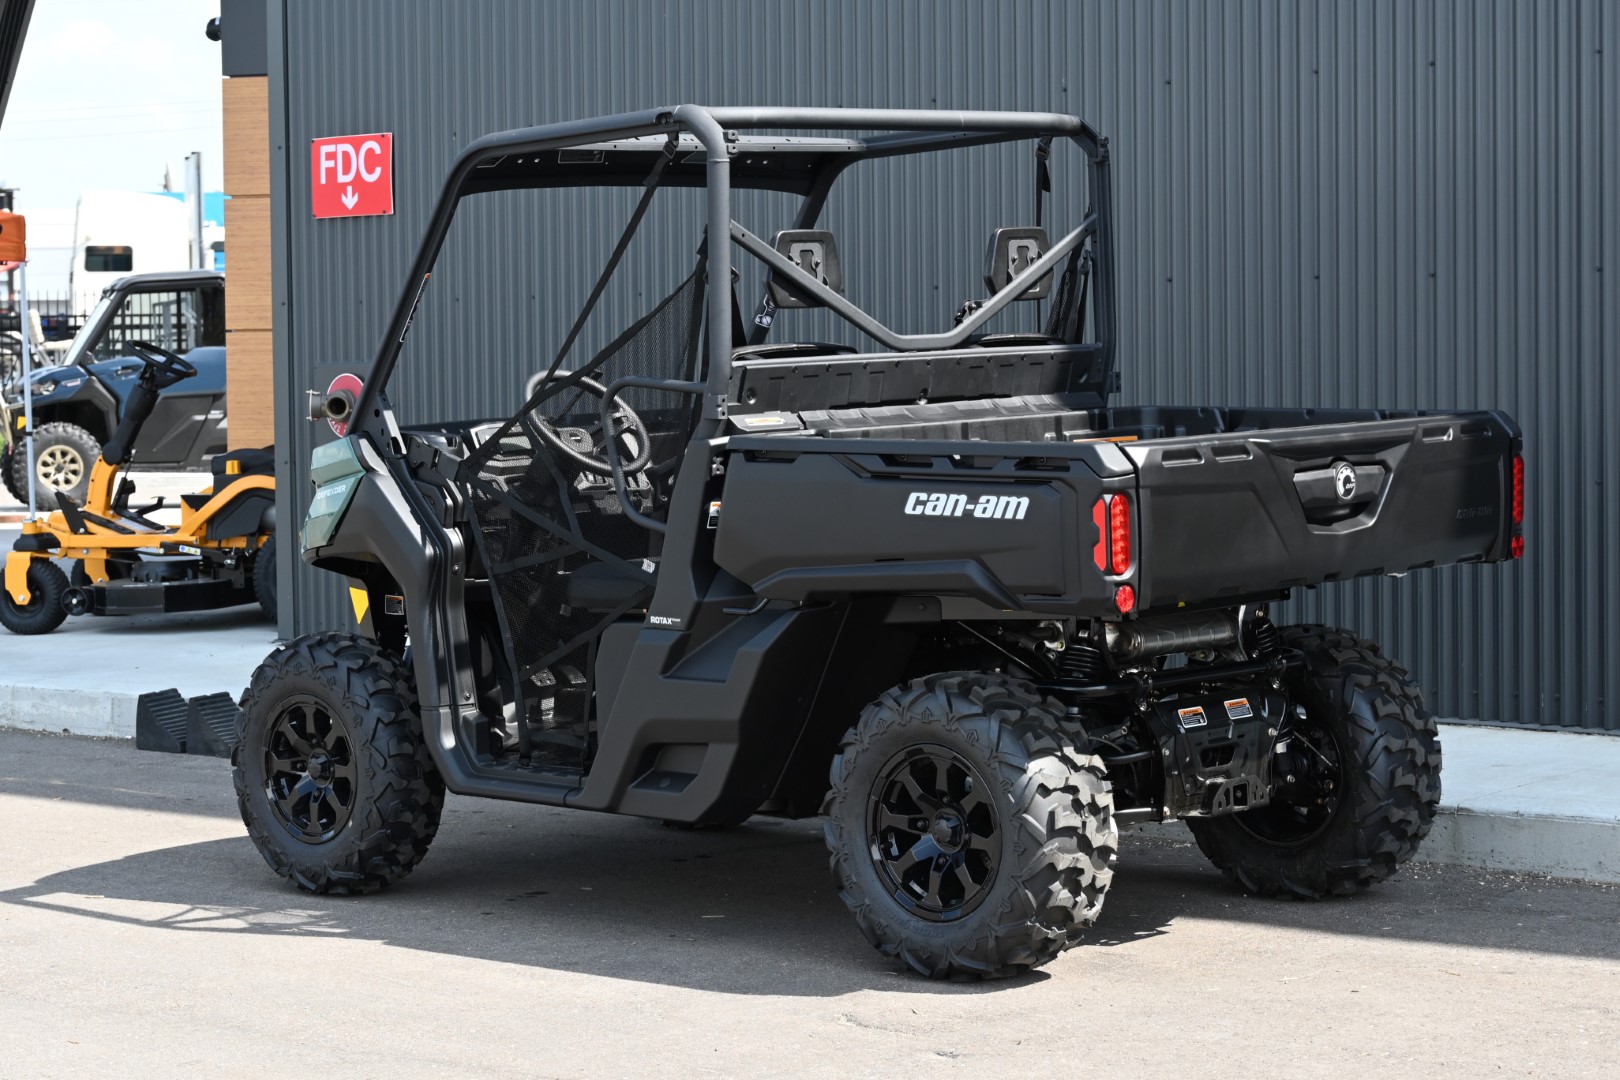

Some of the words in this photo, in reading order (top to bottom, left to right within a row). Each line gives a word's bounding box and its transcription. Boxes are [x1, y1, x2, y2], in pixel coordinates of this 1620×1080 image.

[319, 140, 382, 185] FDC
[317, 484, 346, 500] DEFENDER
[904, 491, 1030, 520] can-am
[650, 615, 673, 625] ROTAX
